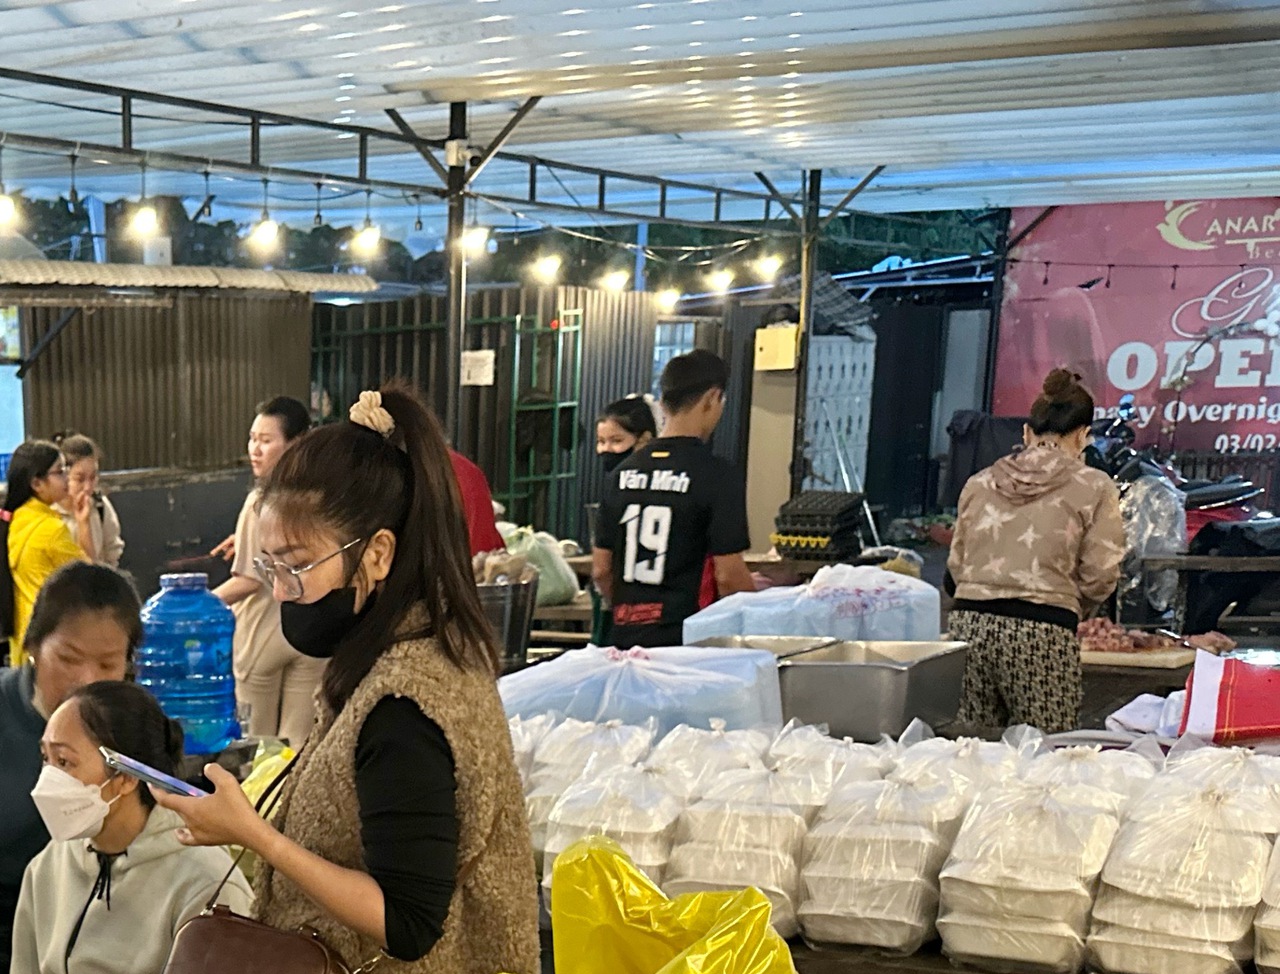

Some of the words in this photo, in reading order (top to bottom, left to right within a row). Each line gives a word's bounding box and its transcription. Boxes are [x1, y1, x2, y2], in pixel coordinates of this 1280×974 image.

[1155, 200, 1280, 250] CANAR
[1214, 433, 1280, 454] 03/02
[650, 470, 690, 493] Minh
[619, 503, 672, 586] 19
